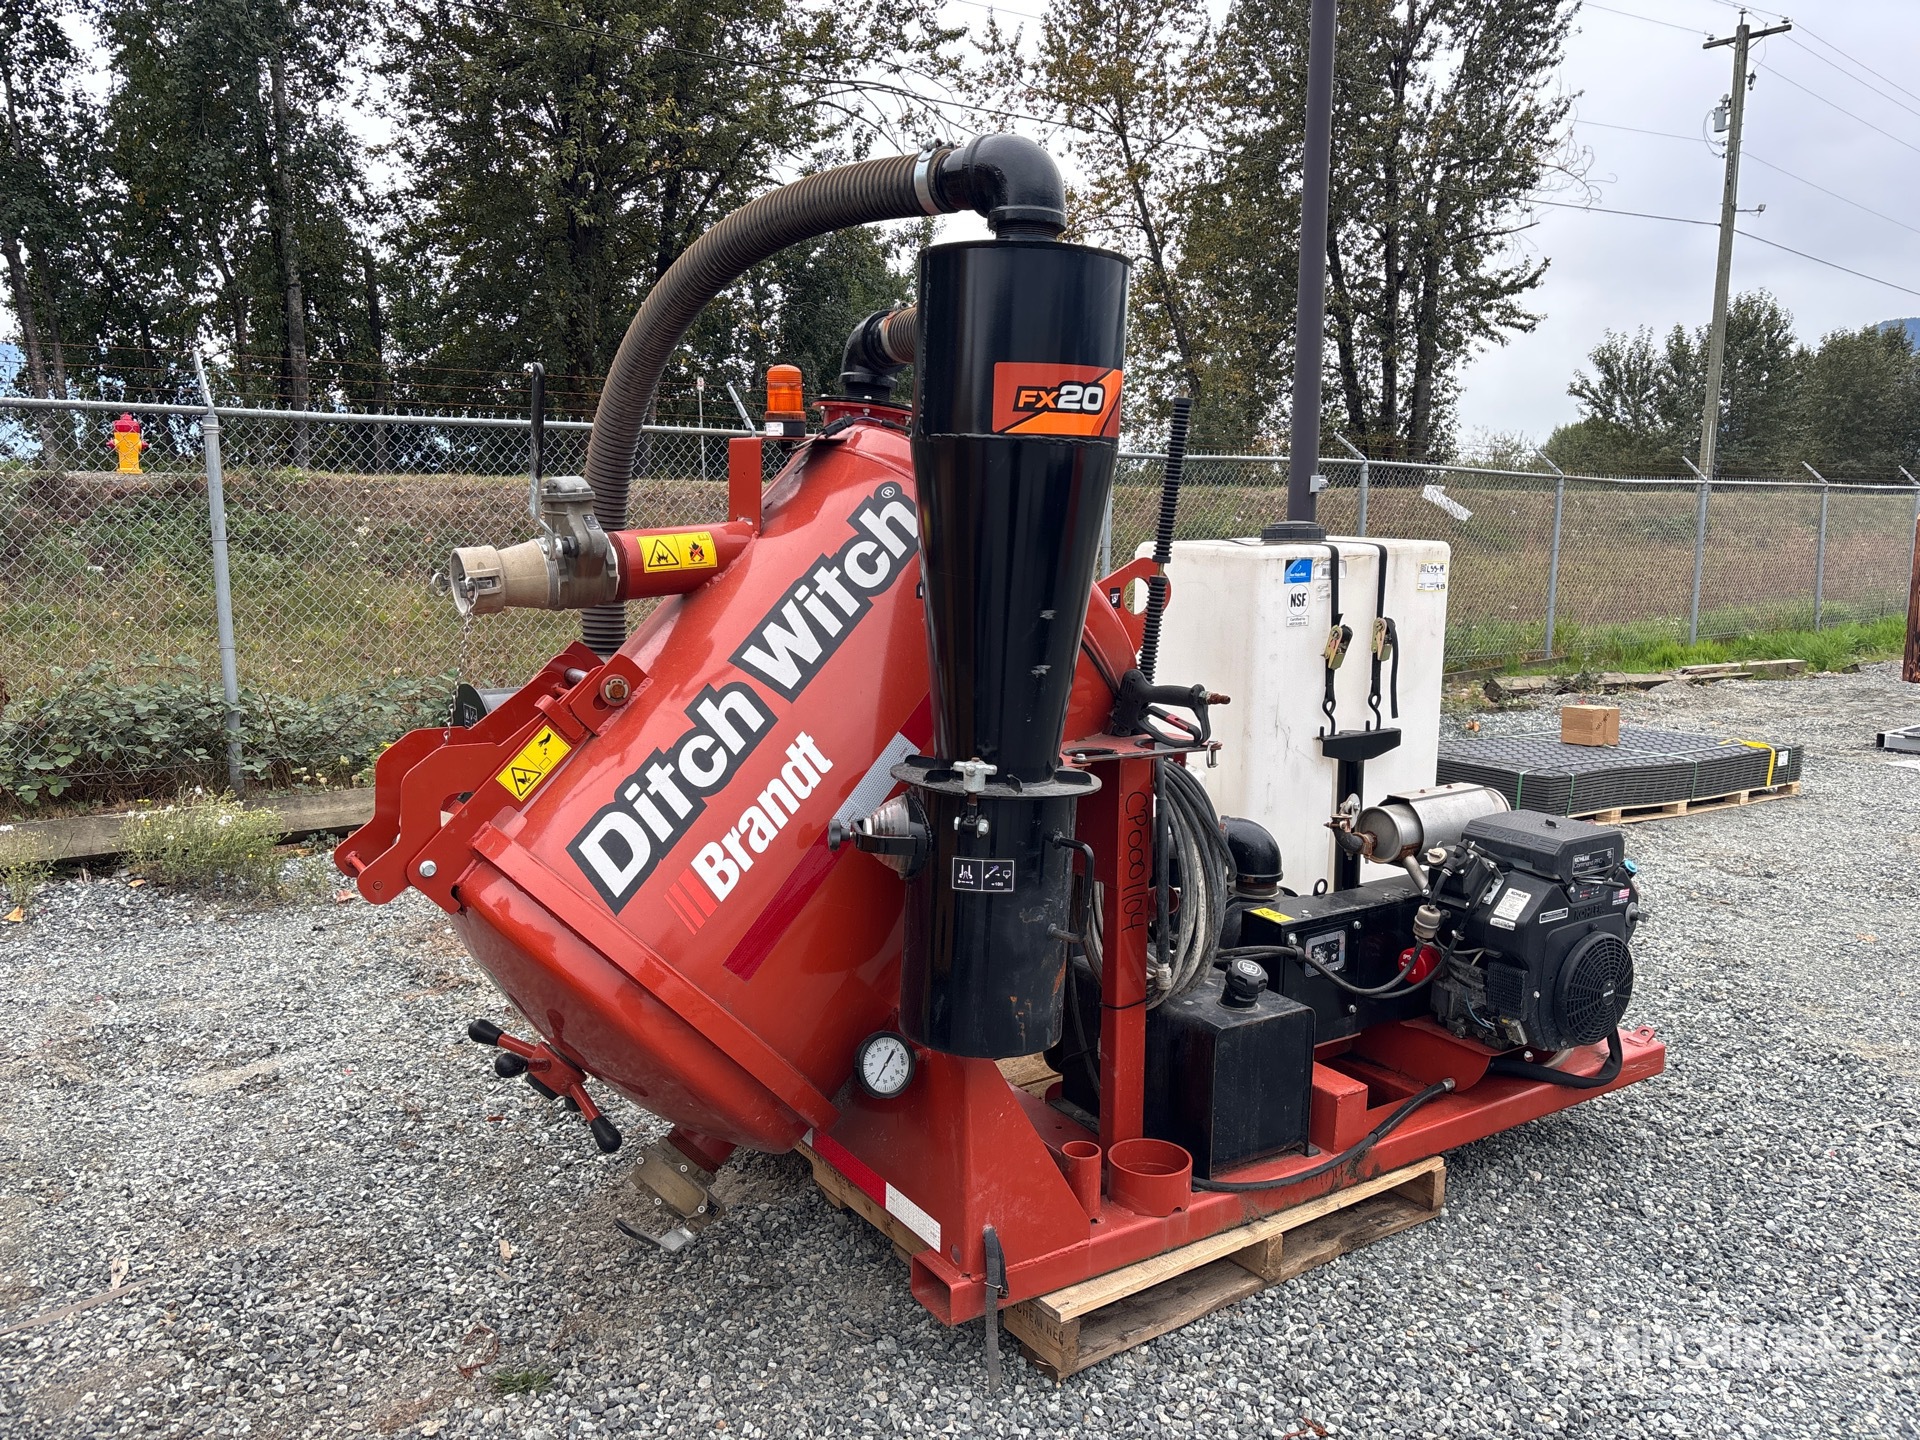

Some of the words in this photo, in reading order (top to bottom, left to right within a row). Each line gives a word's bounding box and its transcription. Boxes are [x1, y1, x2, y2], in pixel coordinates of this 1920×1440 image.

[1017, 384, 1104, 412] FX20
[1290, 592, 1307, 608] NSF
[578, 689, 767, 898] Ditch
[691, 731, 834, 903] Brandt
[1488, 827, 1536, 846] KOHLER
